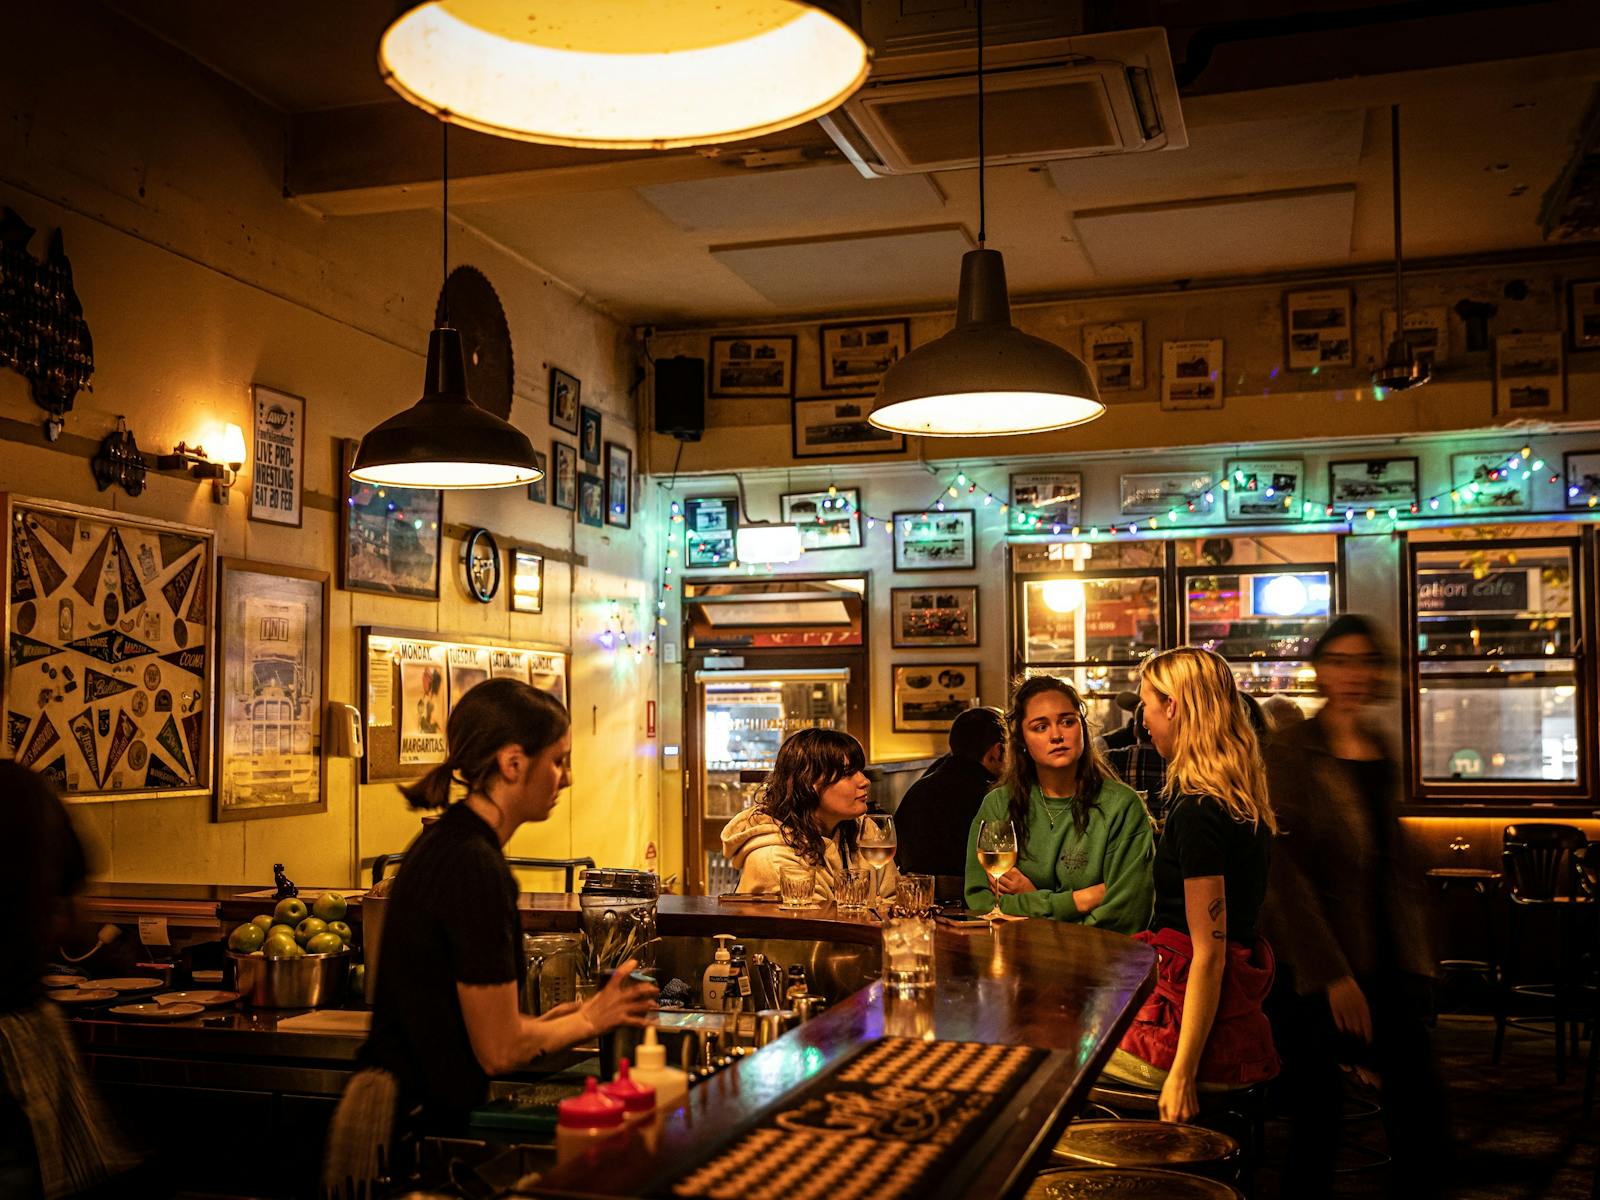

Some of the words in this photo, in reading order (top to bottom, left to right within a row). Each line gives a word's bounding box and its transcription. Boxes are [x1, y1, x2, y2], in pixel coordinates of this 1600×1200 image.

[266, 409, 288, 427] AWF
[256, 439, 273, 464] LIVE
[275, 445, 294, 467] PRO-
[255, 463, 294, 490] WRESTLING
[255, 485, 268, 507] SAT
[280, 491, 293, 511] FEB
[1417, 578, 1468, 598] ation
[401, 643, 433, 662] MONDAY.
[449, 647, 479, 665] TUESDAY.
[402, 737, 445, 753] MARGARITAS.
